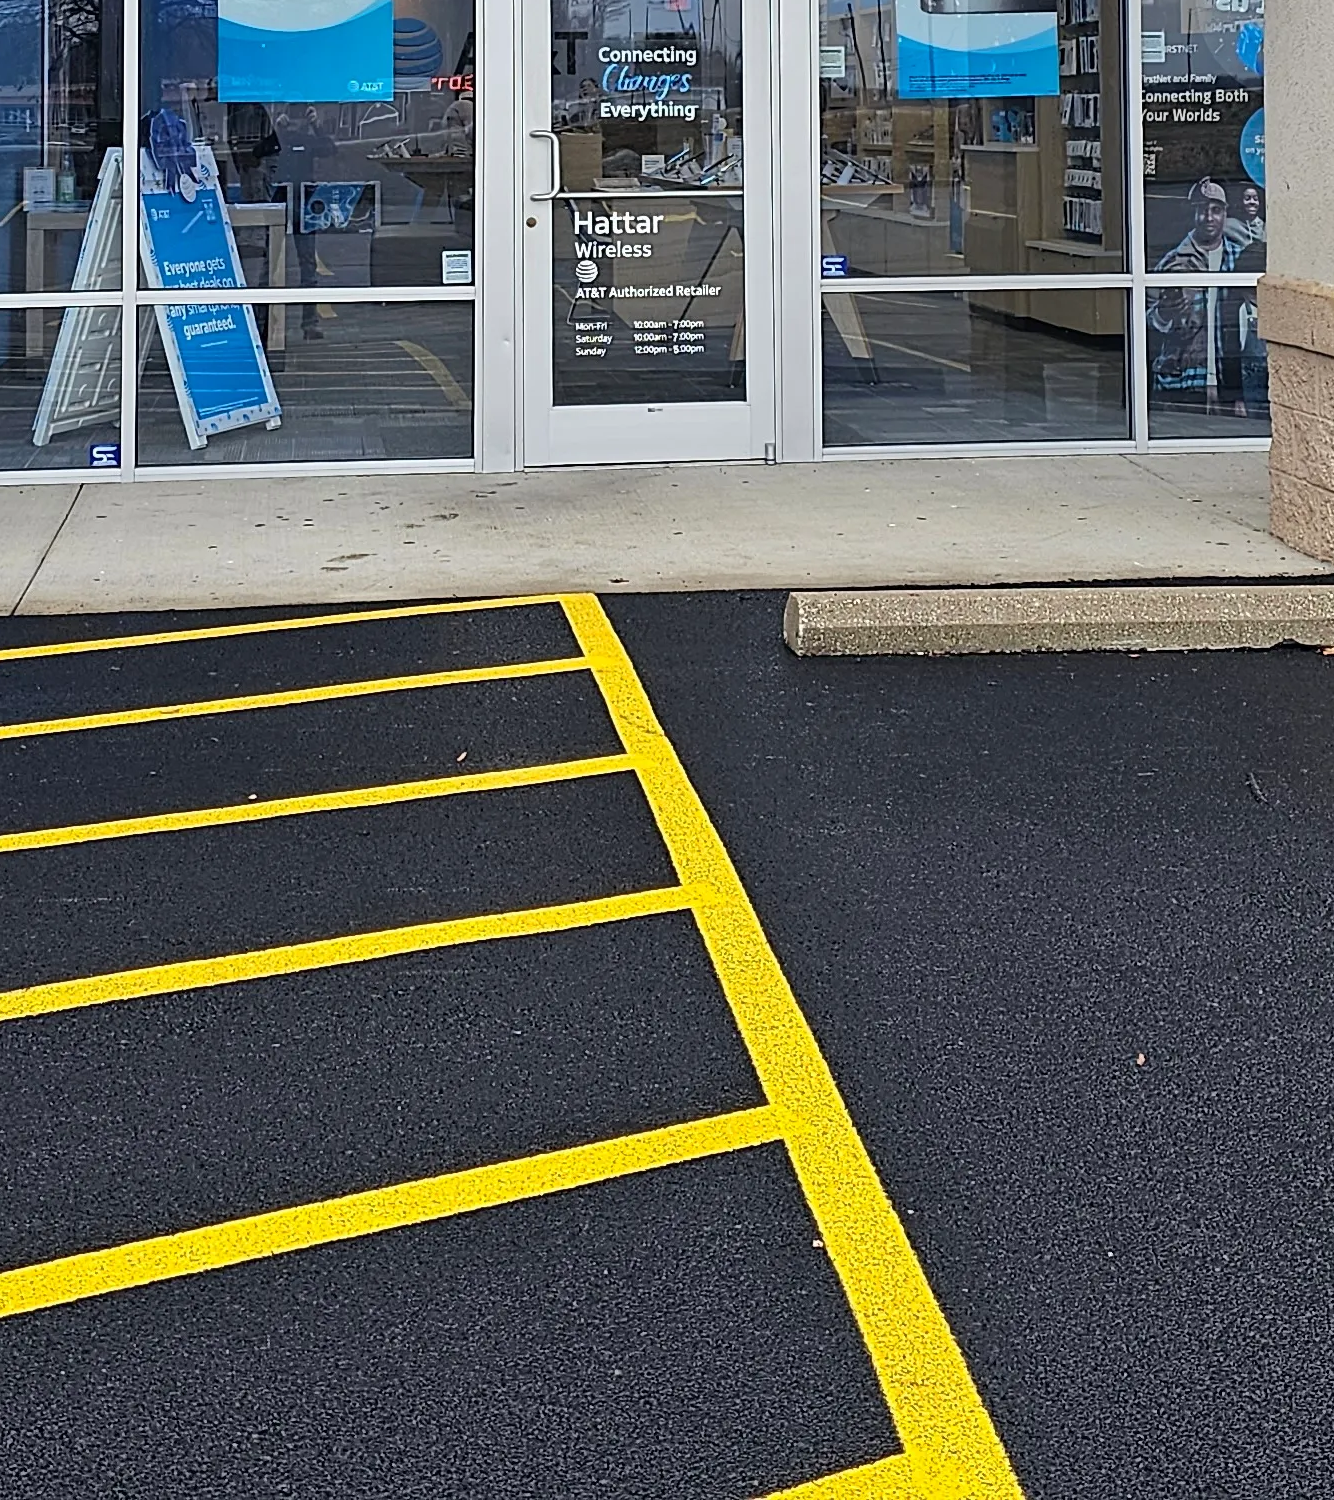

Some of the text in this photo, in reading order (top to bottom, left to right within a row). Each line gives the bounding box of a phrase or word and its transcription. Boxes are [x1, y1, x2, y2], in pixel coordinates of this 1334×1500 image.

[598, 45, 697, 66] Connecting
[602, 63, 693, 101] Changes
[1172, 74, 1188, 83] and
[1190, 74, 1217, 85] Family
[1215, 89, 1249, 103] Both
[600, 101, 698, 122] Everything
[1172, 108, 1221, 122] Worlds
[574, 211, 664, 235] Hattar
[574, 241, 652, 258] Wireless
[163, 256, 226, 278] Everyone gets
[575, 284, 722, 299] AT&T Authorized Retailer
[183, 314, 237, 341] guaranteed.
[575, 321, 608, 331] Mon-Fri
[575, 334, 613, 345] Saturday
[575, 346, 607, 358] Sunday
